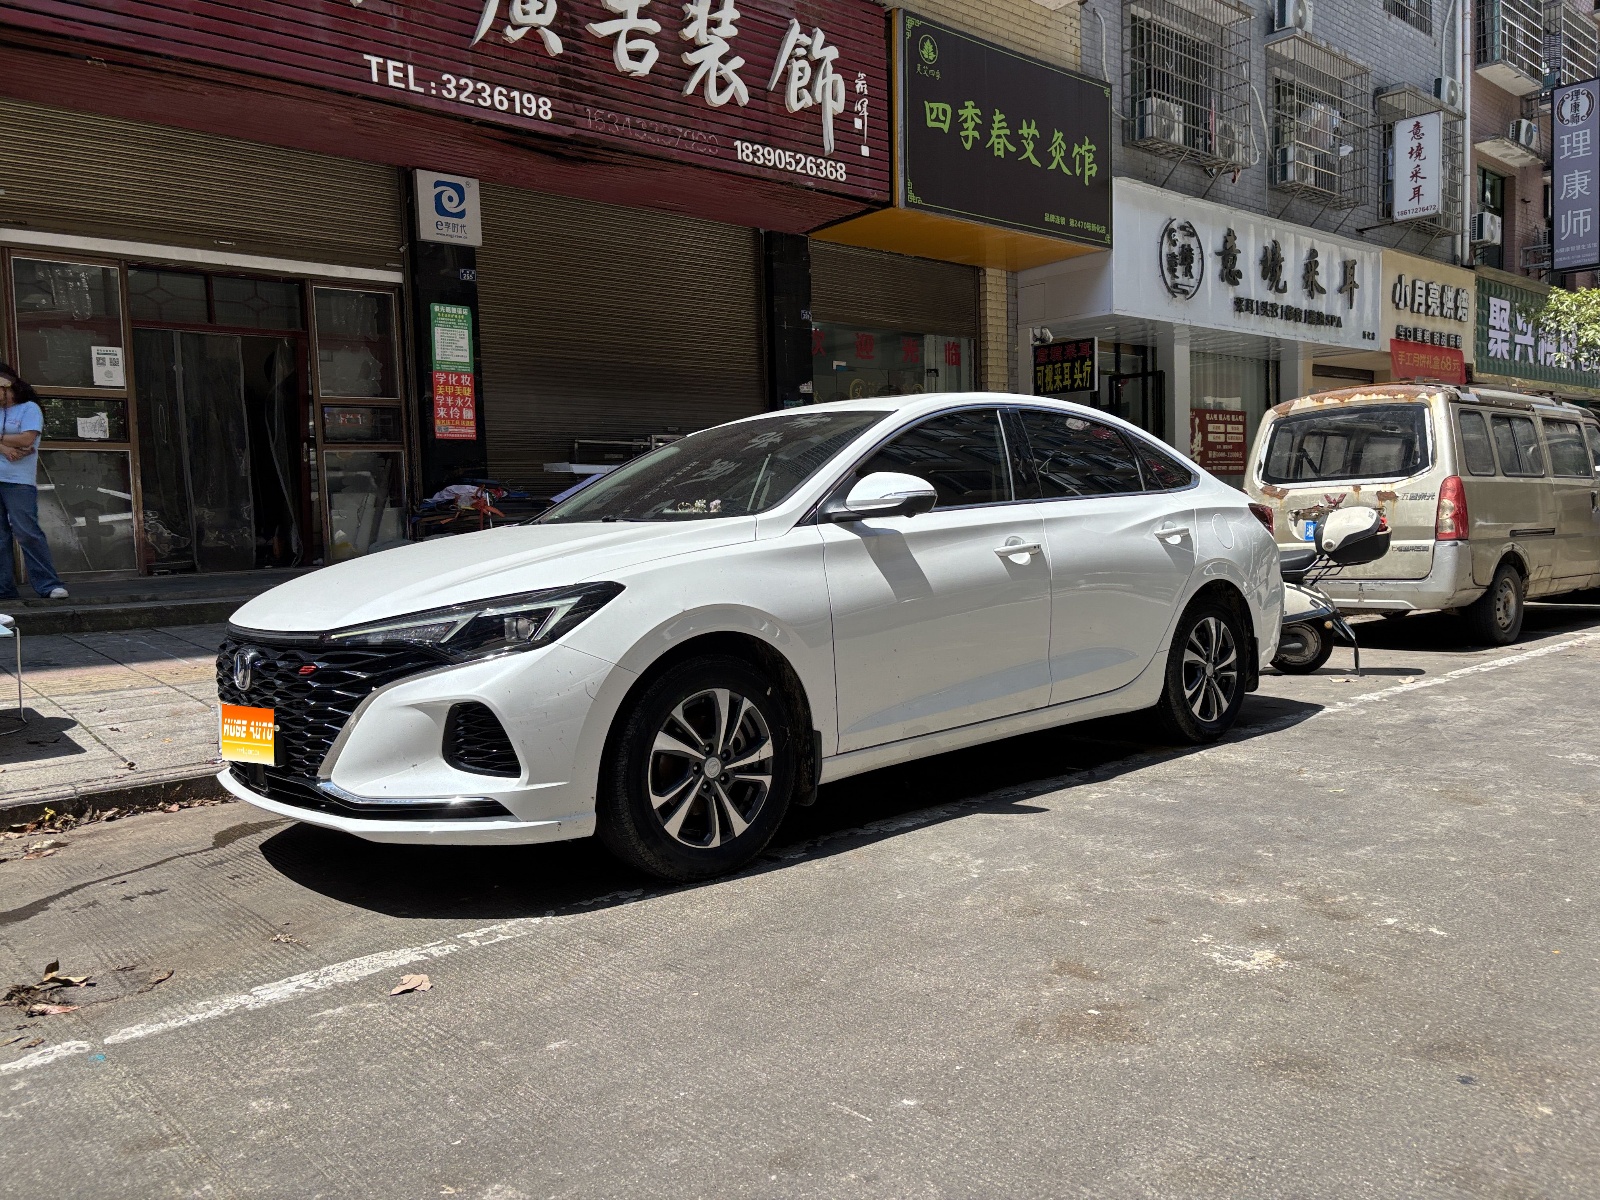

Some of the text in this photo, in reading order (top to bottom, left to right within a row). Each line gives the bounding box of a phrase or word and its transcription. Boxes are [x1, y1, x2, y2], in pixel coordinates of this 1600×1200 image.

[733, 140, 847, 182] 18390526368
[924, 100, 1098, 186] 四季春艾灸馆
[1407, 120, 1428, 205] 意境采耳
[1559, 128, 1593, 241] 理康师
[1215, 227, 1360, 310] 意境采耳
[1392, 273, 1470, 323] 小月亮烘焙
[435, 372, 471, 386] 学化妆
[435, 395, 473, 407] 学半永久
[436, 385, 472, 397] 美甲美睫
